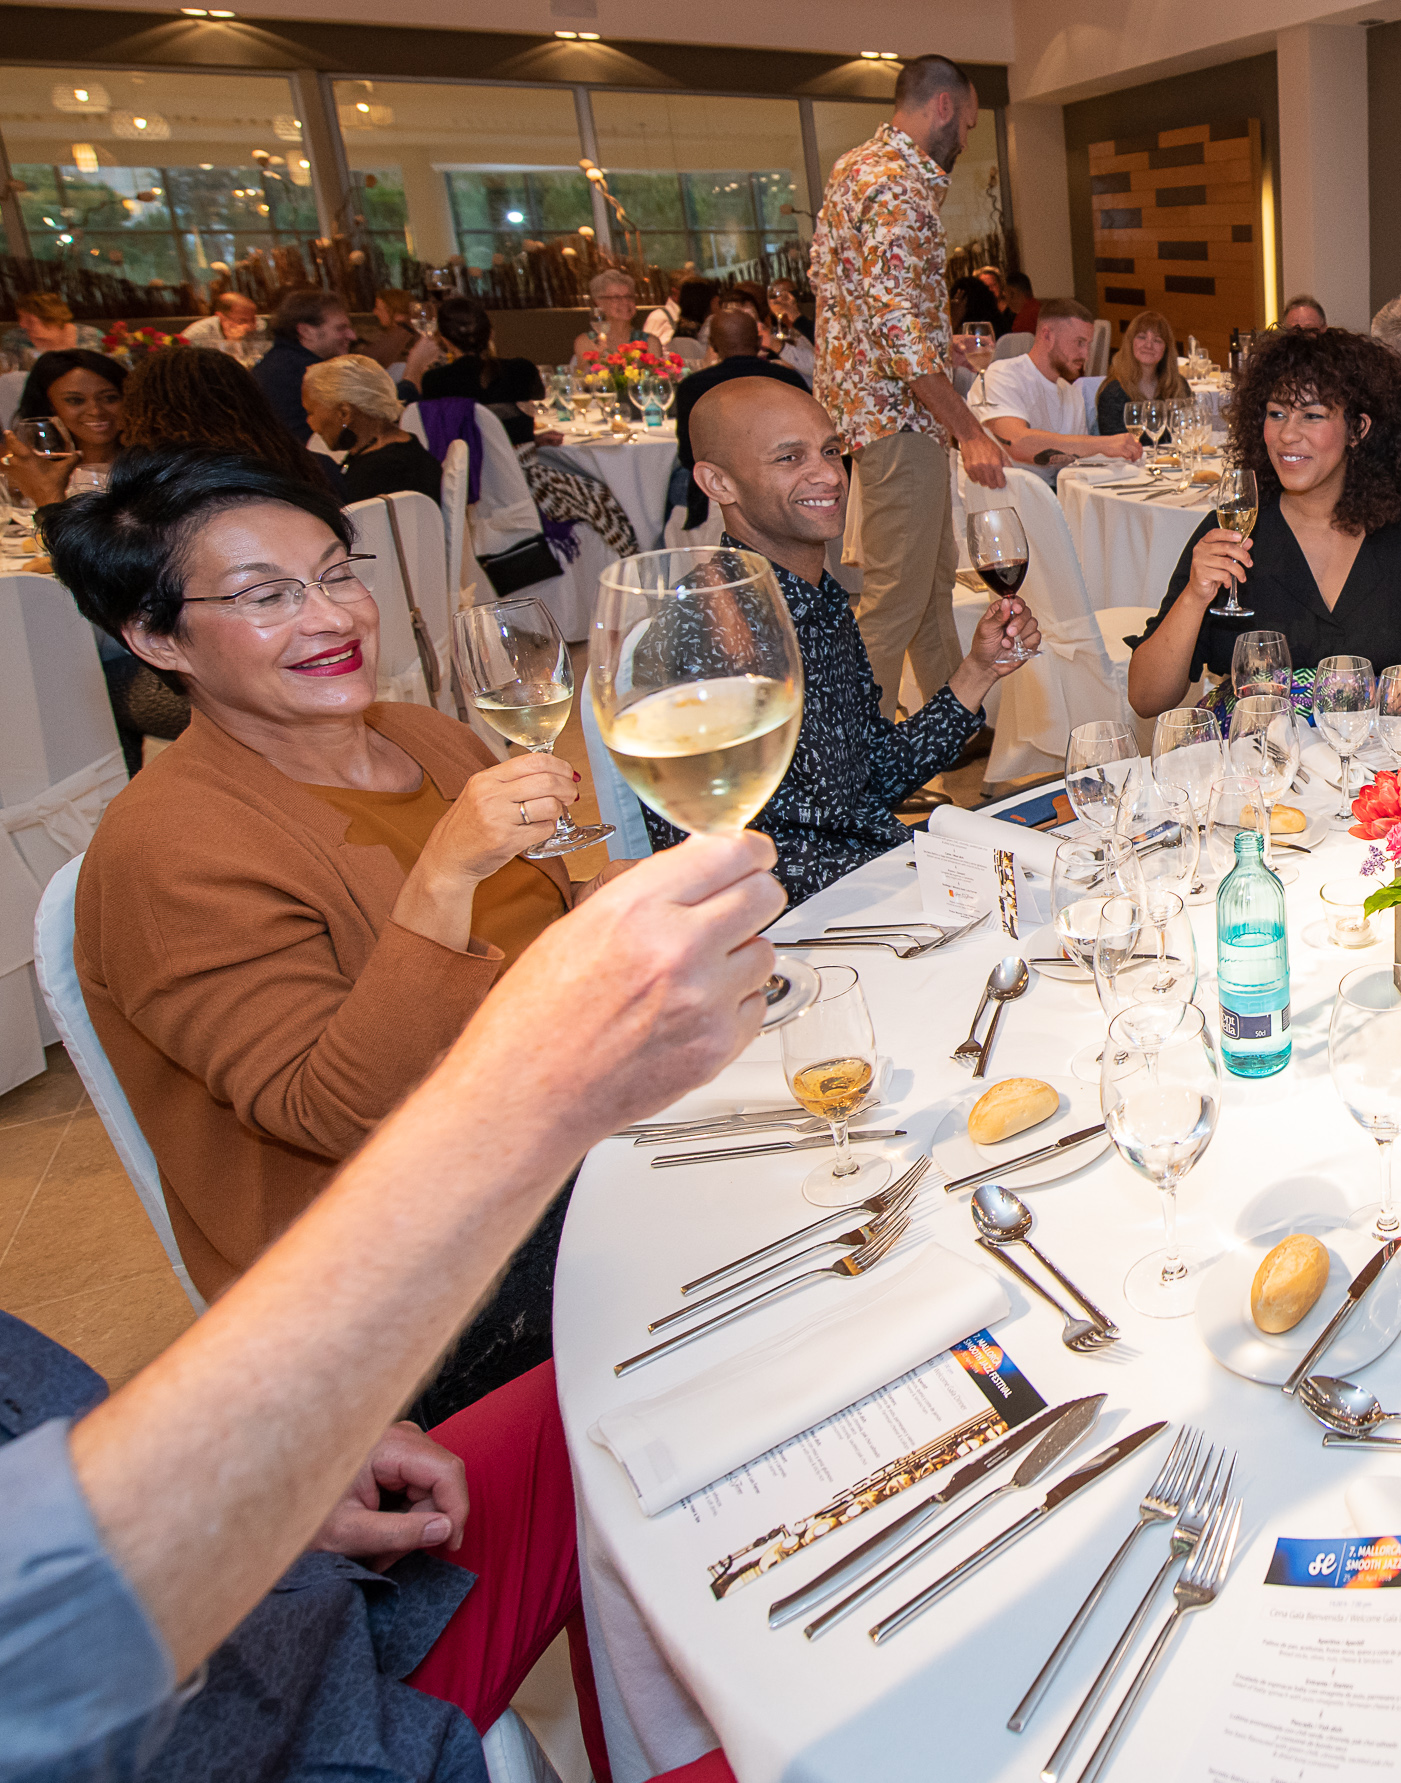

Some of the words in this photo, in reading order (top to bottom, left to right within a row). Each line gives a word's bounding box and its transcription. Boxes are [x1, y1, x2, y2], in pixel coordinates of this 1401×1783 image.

[1222, 1014, 1235, 1025] ont
[978, 1339, 1001, 1366] MALLORCA
[964, 1341, 983, 1361] SMOOTH
[979, 1360, 994, 1374] JAZZ
[989, 1372, 1011, 1398] FESTIVAL
[1349, 1546, 1356, 1557] 7.
[1358, 1544, 1401, 1556] MALLORCA
[1346, 1559, 1381, 1570] SMOOTH
